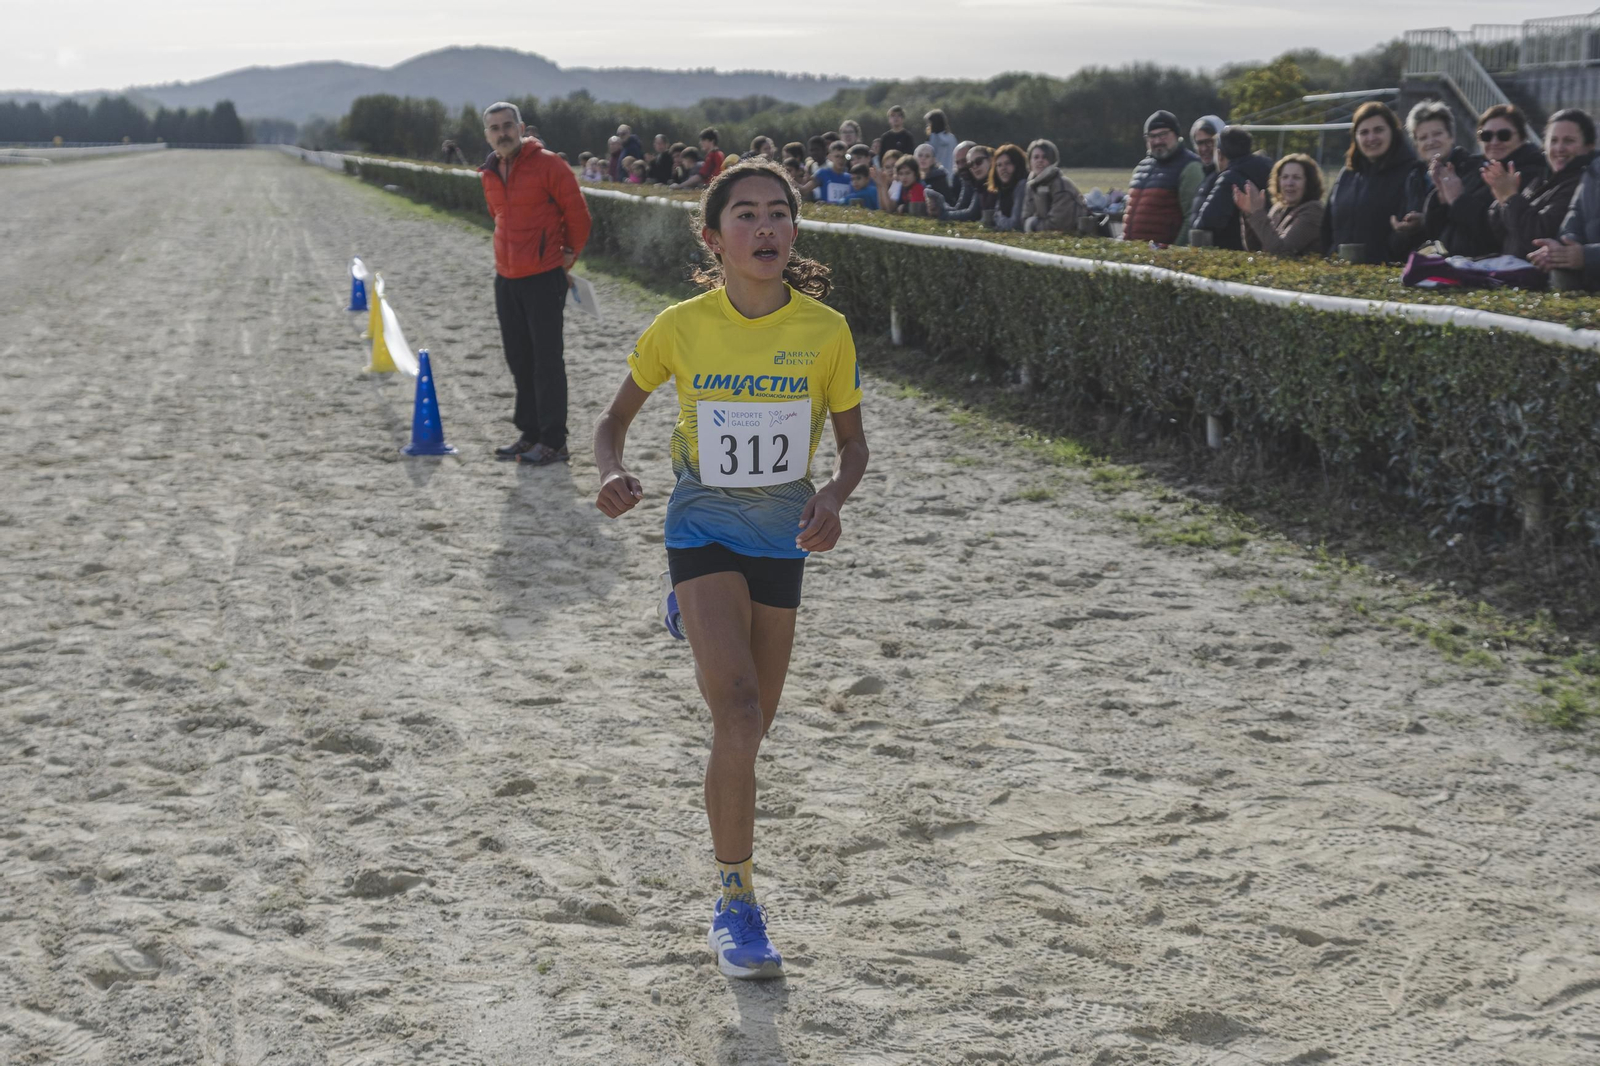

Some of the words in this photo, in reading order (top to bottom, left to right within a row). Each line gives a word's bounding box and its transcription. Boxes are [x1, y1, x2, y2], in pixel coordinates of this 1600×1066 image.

[693, 373, 809, 396] LIMIACTIVA
[731, 411, 763, 419] DEPORTE
[720, 433, 789, 475] 312
